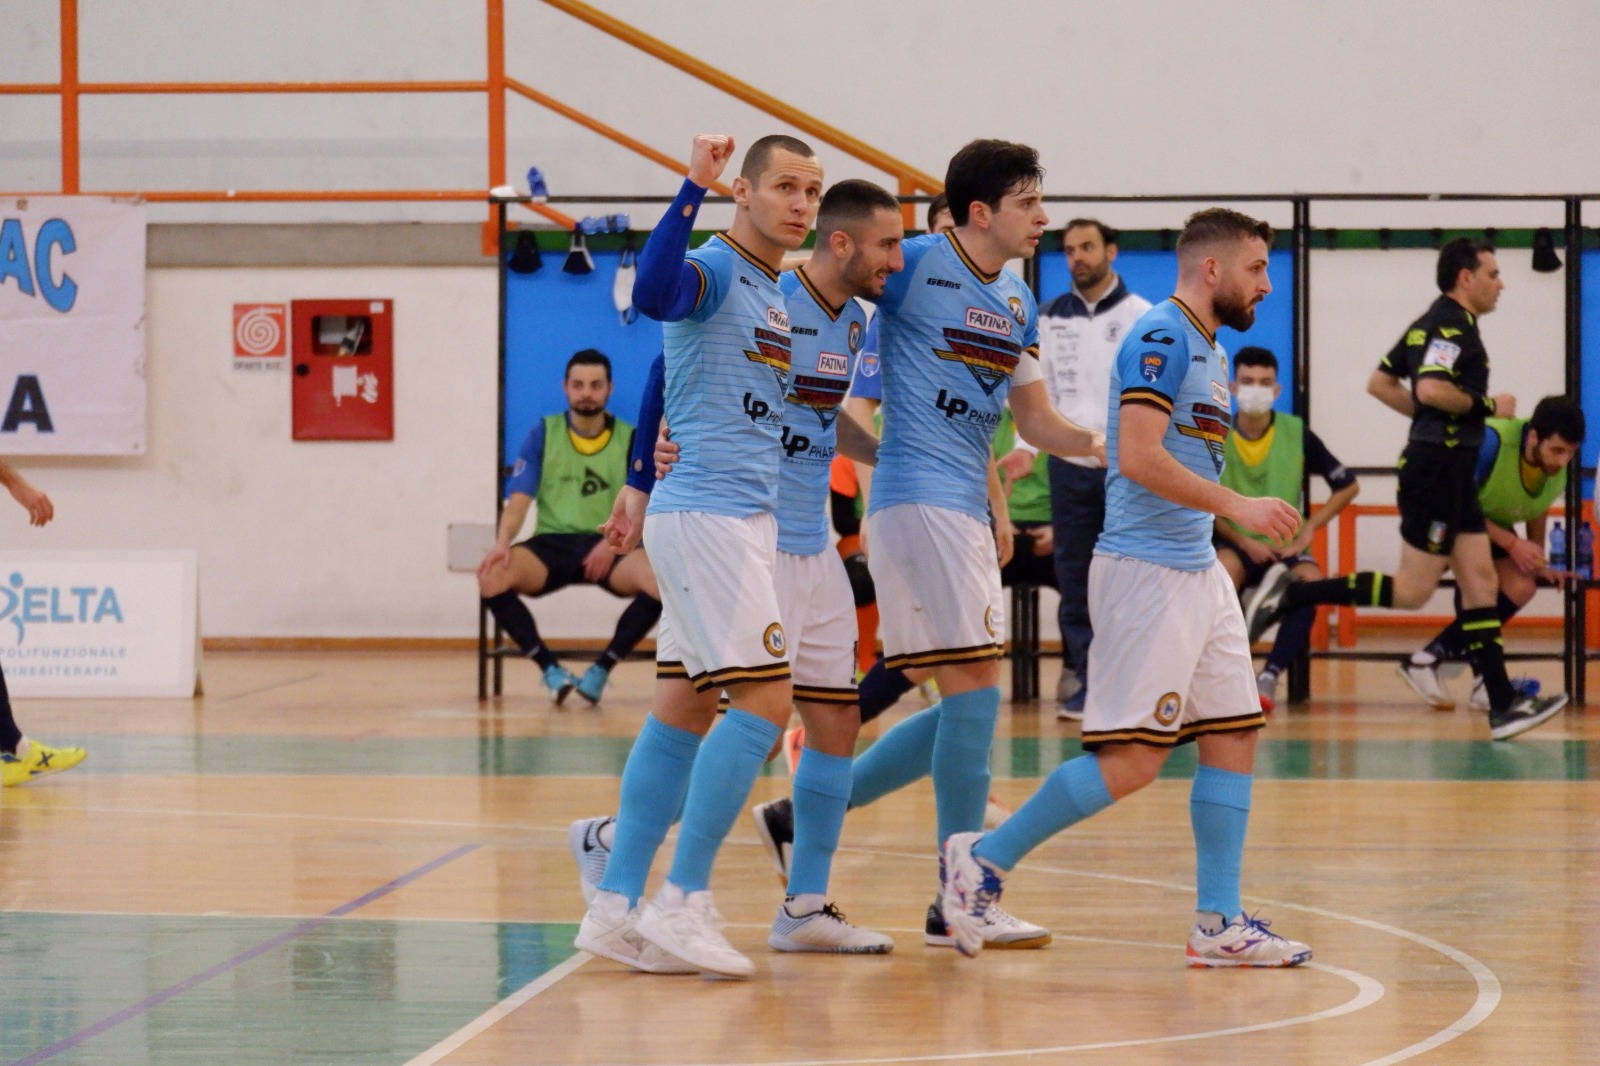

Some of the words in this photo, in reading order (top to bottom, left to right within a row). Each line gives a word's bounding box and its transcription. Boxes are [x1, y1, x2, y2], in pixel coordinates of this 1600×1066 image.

[968, 311, 1010, 332] FATINA
[820, 356, 847, 371] FATINA
[1, 374, 55, 433] A
